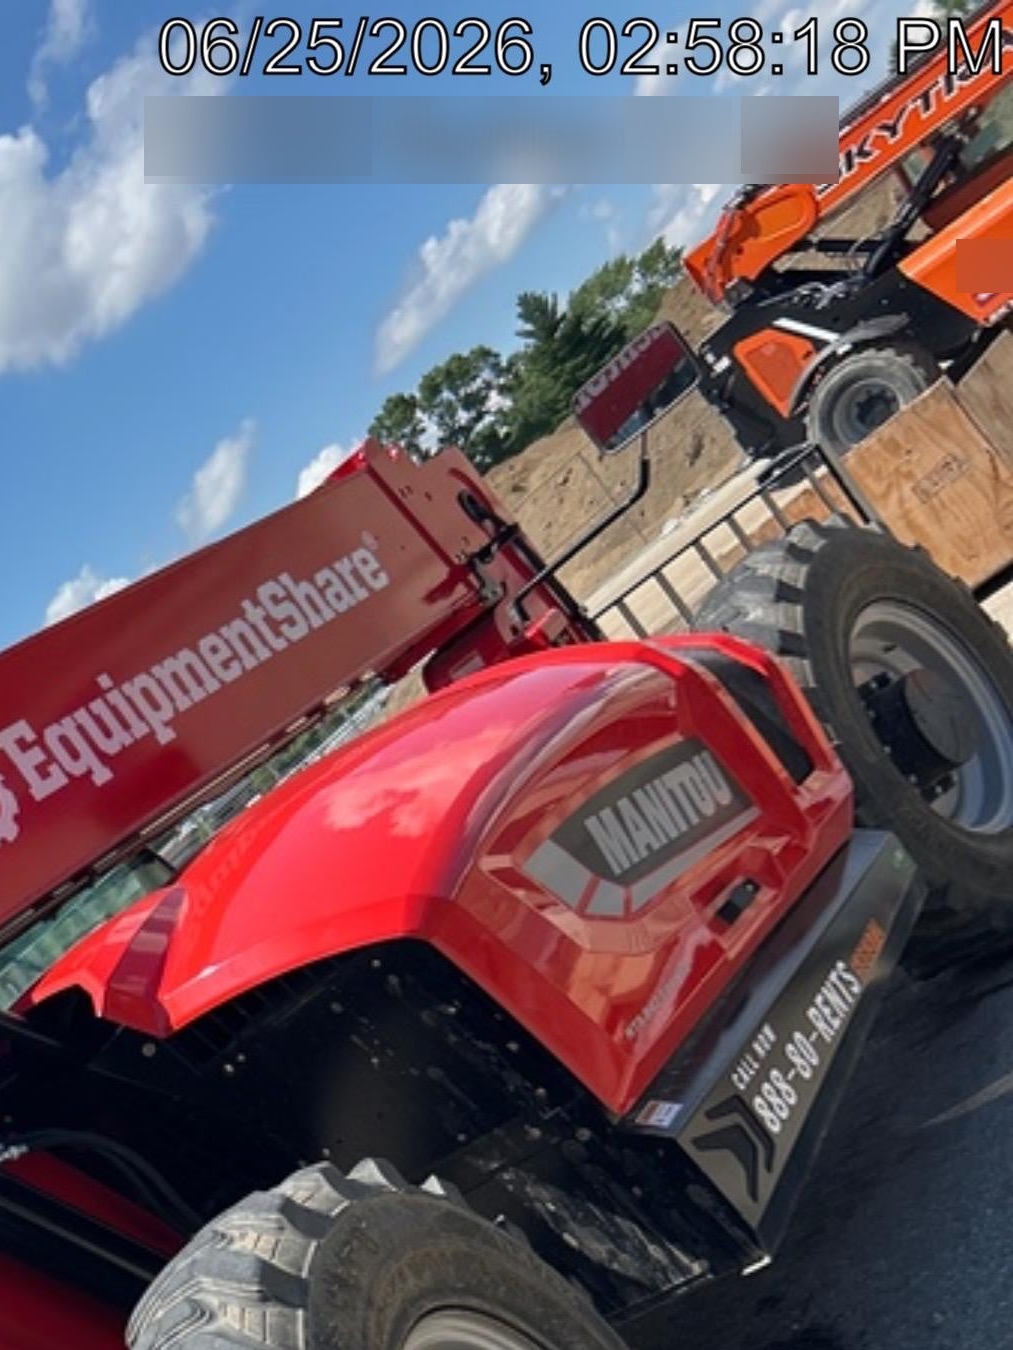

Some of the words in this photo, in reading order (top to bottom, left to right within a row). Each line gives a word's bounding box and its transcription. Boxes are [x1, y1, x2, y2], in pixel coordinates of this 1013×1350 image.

[585, 751, 734, 875] MANITOU
[731, 1055, 759, 1090] CALL
[752, 960, 862, 1133] 888-80-RENTS
